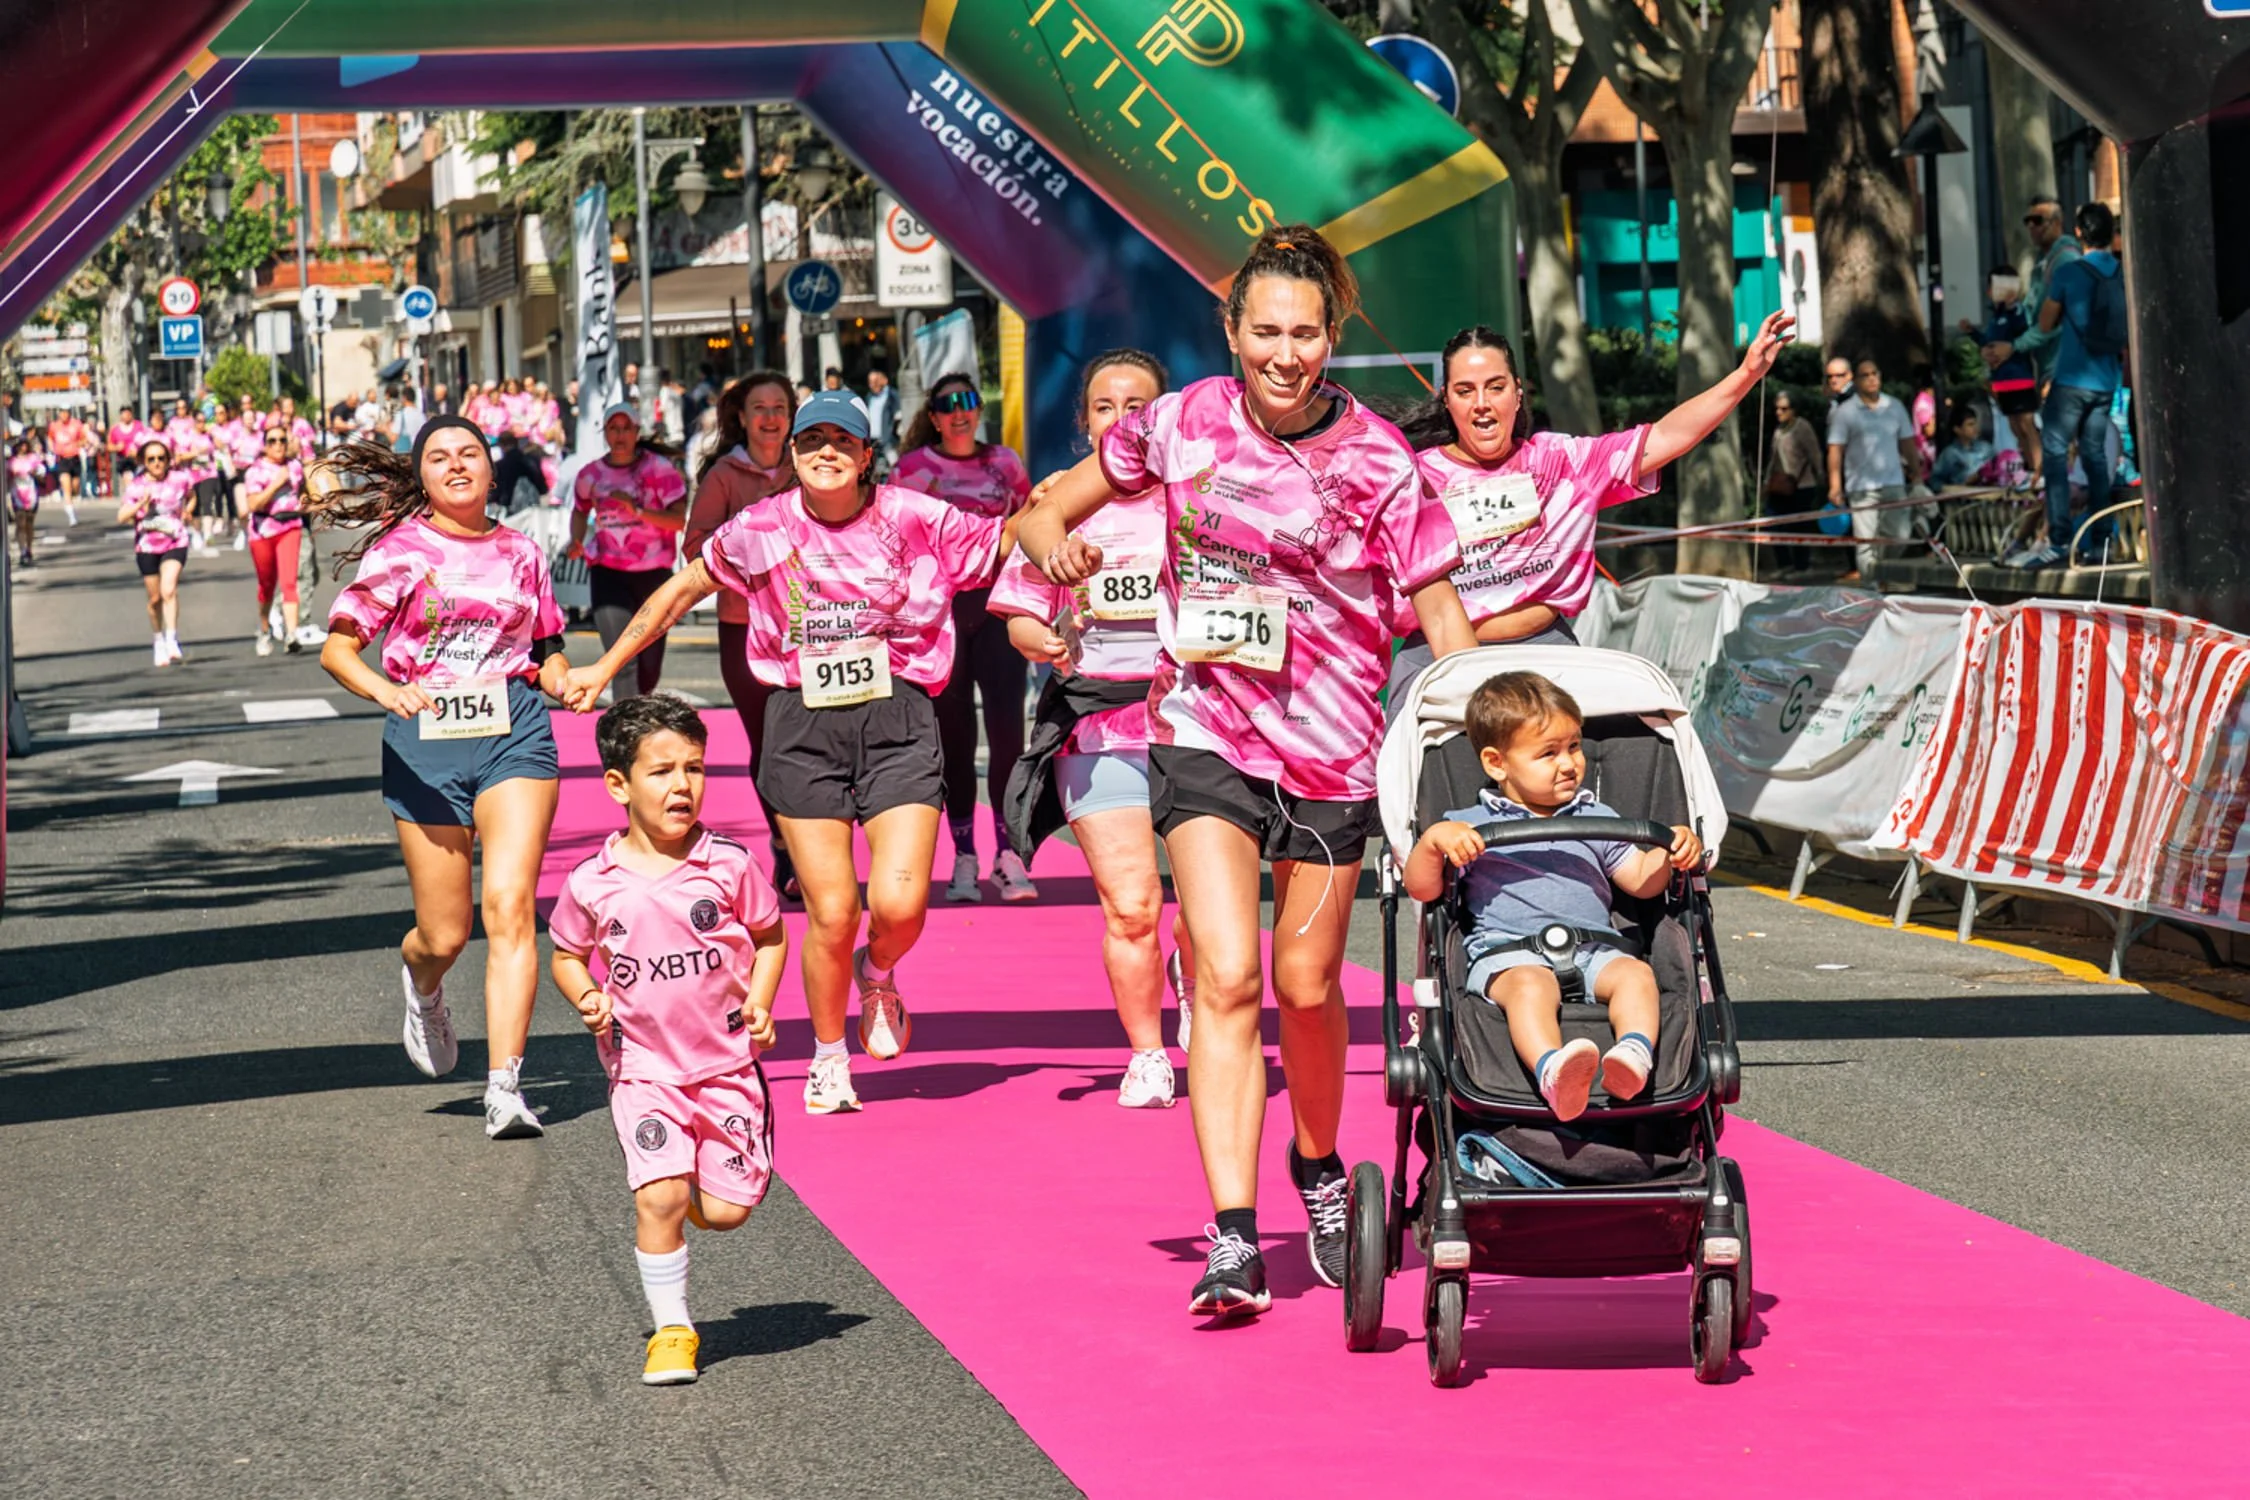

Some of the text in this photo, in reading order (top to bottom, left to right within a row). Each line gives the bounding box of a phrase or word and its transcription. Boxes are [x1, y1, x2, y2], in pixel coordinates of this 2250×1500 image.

[930, 69, 1068, 199] nuestra
[907, 89, 1041, 226] vocación.
[899, 264, 931, 275] ZONA
[168, 292, 191, 305] 30
[168, 323, 194, 341] VP
[1201, 509, 1222, 530] XI
[1198, 534, 1268, 567] Carrera
[1459, 539, 1506, 555] arrera
[1198, 555, 1250, 576] por la
[1476, 558, 1493, 571] la
[1455, 558, 1554, 593] nvestigación
[806, 581, 821, 593] XI
[441, 598, 456, 611] XI
[784, 578, 805, 647] mujer
[806, 599, 868, 611] Carrera
[441, 616, 494, 628] Carrera
[806, 615, 852, 632] por la
[816, 656, 874, 689] 9153
[434, 694, 494, 721] 9154
[648, 948, 722, 982] XBTO
